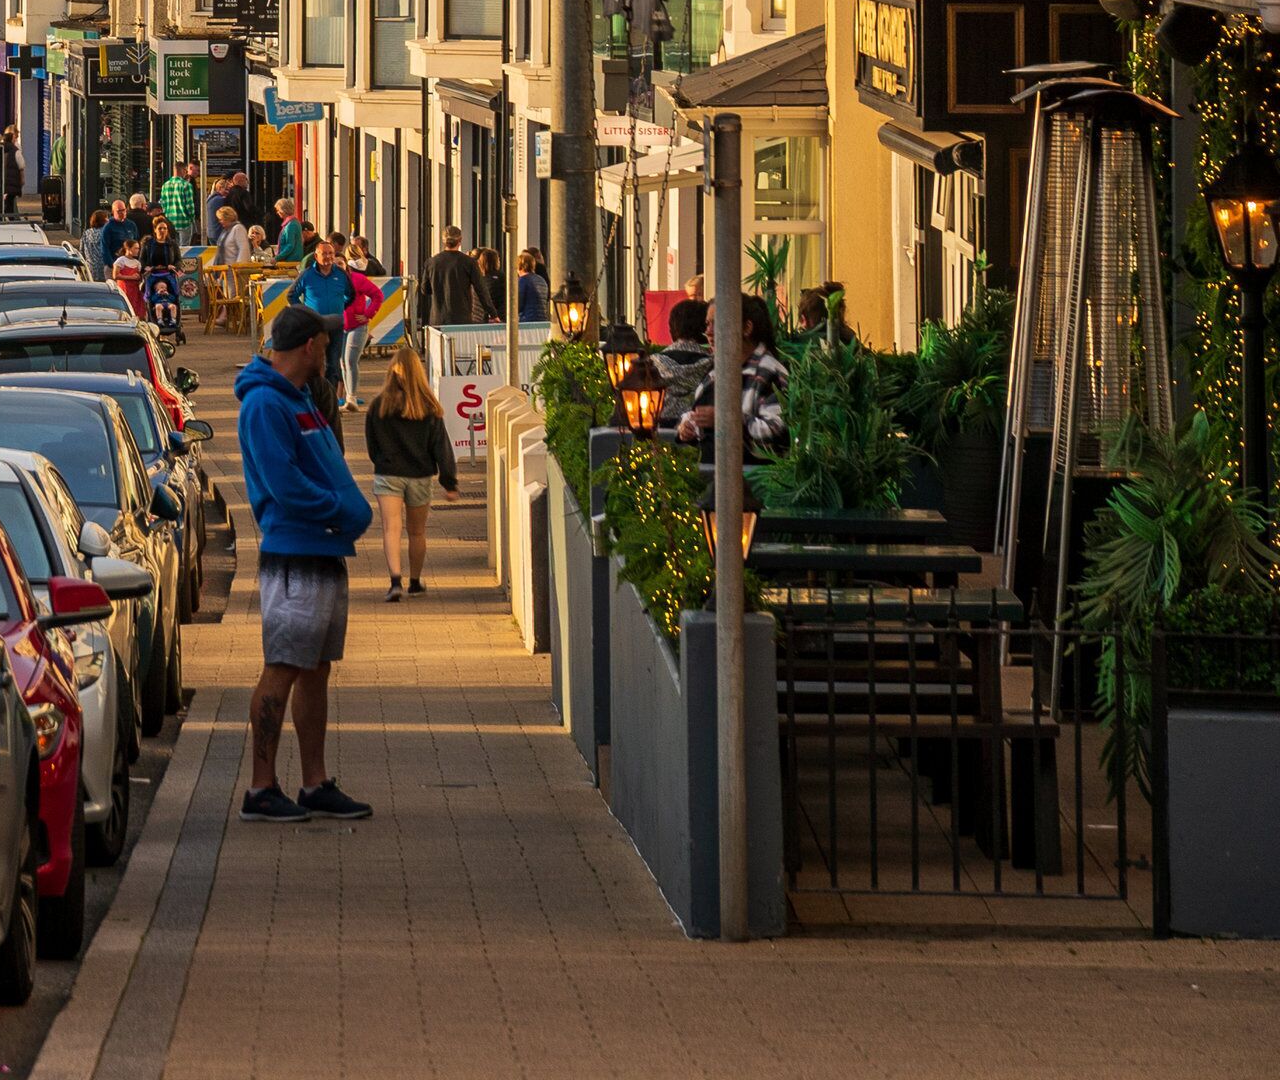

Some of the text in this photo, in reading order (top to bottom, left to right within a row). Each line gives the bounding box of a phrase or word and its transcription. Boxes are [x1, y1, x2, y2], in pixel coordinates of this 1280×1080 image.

[169, 60, 192, 68] Little
[169, 69, 190, 77] Rock
[169, 87, 200, 95] Ireland
[274, 102, 315, 116] berts
